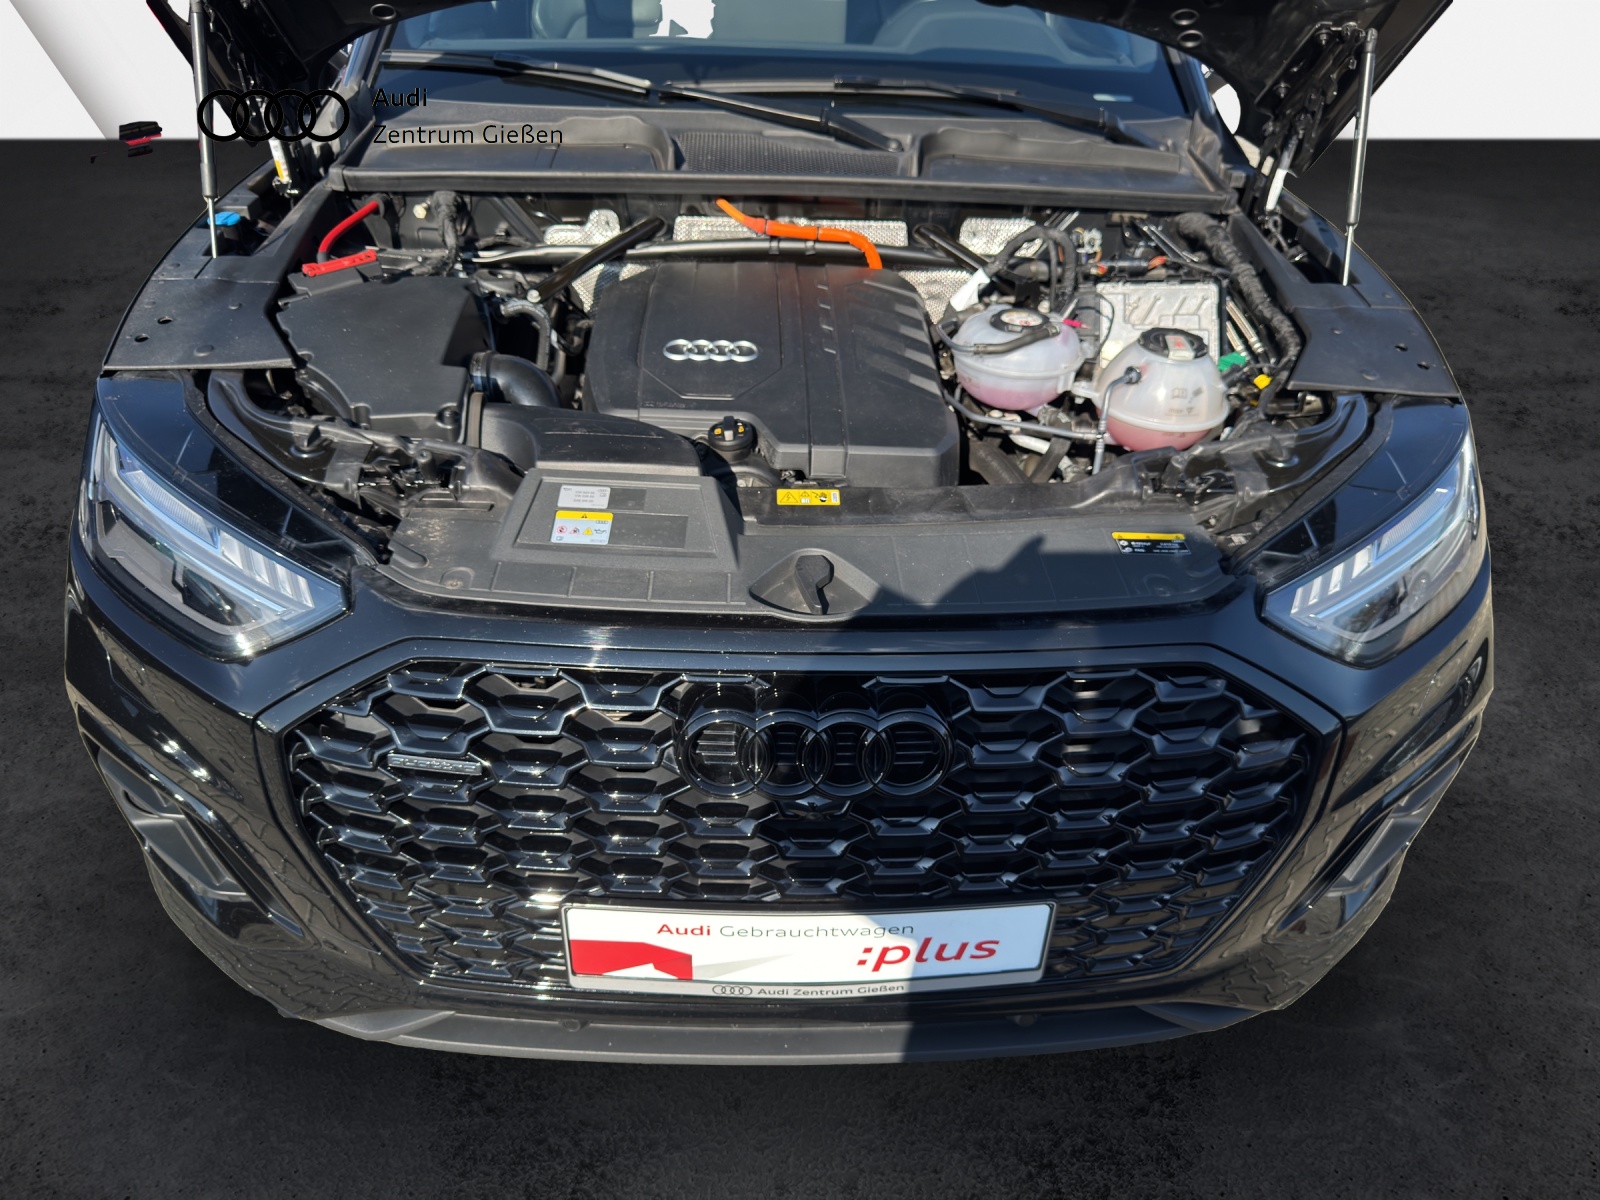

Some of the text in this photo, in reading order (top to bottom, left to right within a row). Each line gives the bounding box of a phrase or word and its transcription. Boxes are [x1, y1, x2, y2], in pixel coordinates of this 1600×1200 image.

[657, 924, 914, 938] Audi Gebrauchtwagen
[857, 937, 1000, 972] :plus
[757, 985, 905, 997] Audi Zentrum Gießen
